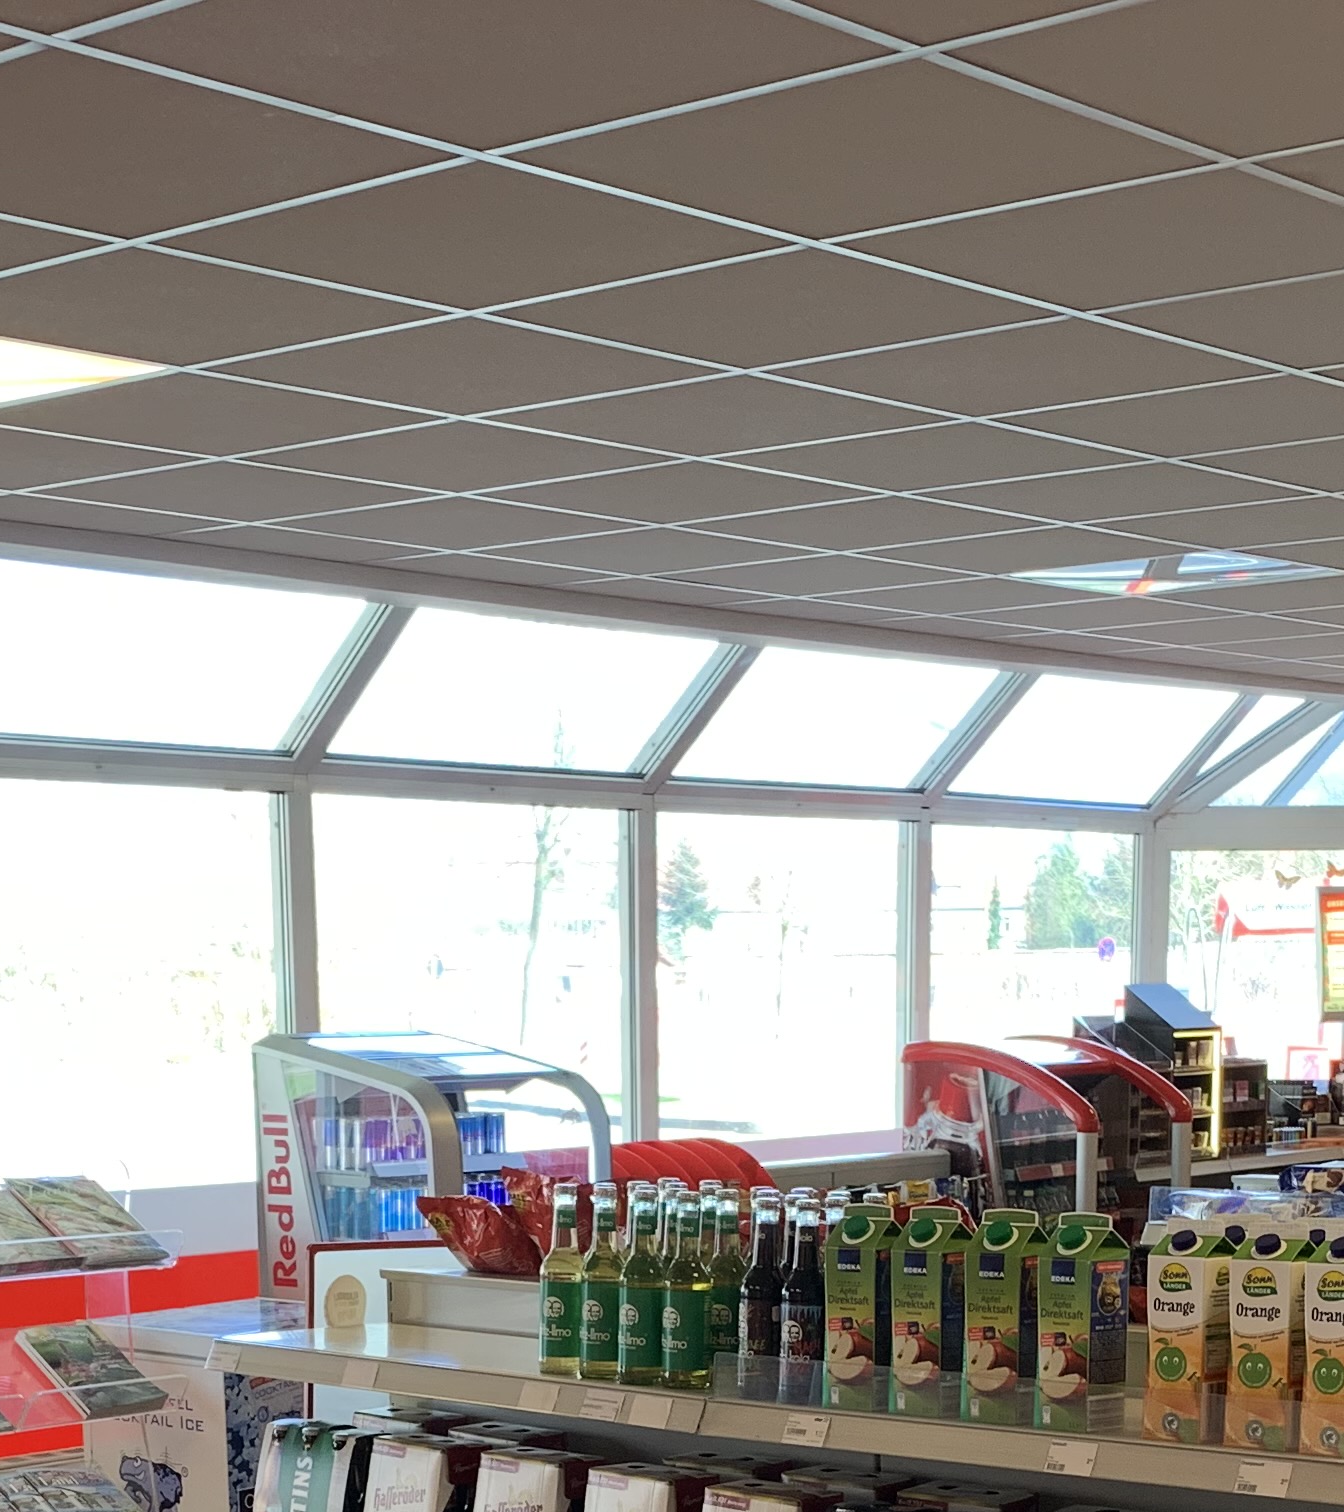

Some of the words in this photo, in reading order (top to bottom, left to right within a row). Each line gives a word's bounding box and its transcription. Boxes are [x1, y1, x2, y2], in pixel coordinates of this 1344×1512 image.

[263, 1112, 292, 1197] Bull
[273, 1203, 298, 1289] Red
[836, 1263, 861, 1271] EDEKA
[903, 1266, 927, 1275] EDEKA
[978, 1270, 1005, 1279] EDEKA
[1050, 1274, 1076, 1283] EDEKA
[828, 1294, 869, 1306] Direktsaft
[894, 1298, 936, 1310] Direktsaft
[1153, 1297, 1195, 1314] Orange
[967, 1303, 1014, 1316] Direktsaft
[1040, 1307, 1084, 1321] Direktsaft
[1236, 1302, 1281, 1319] Orange
[180, 1416, 205, 1432] ICE
